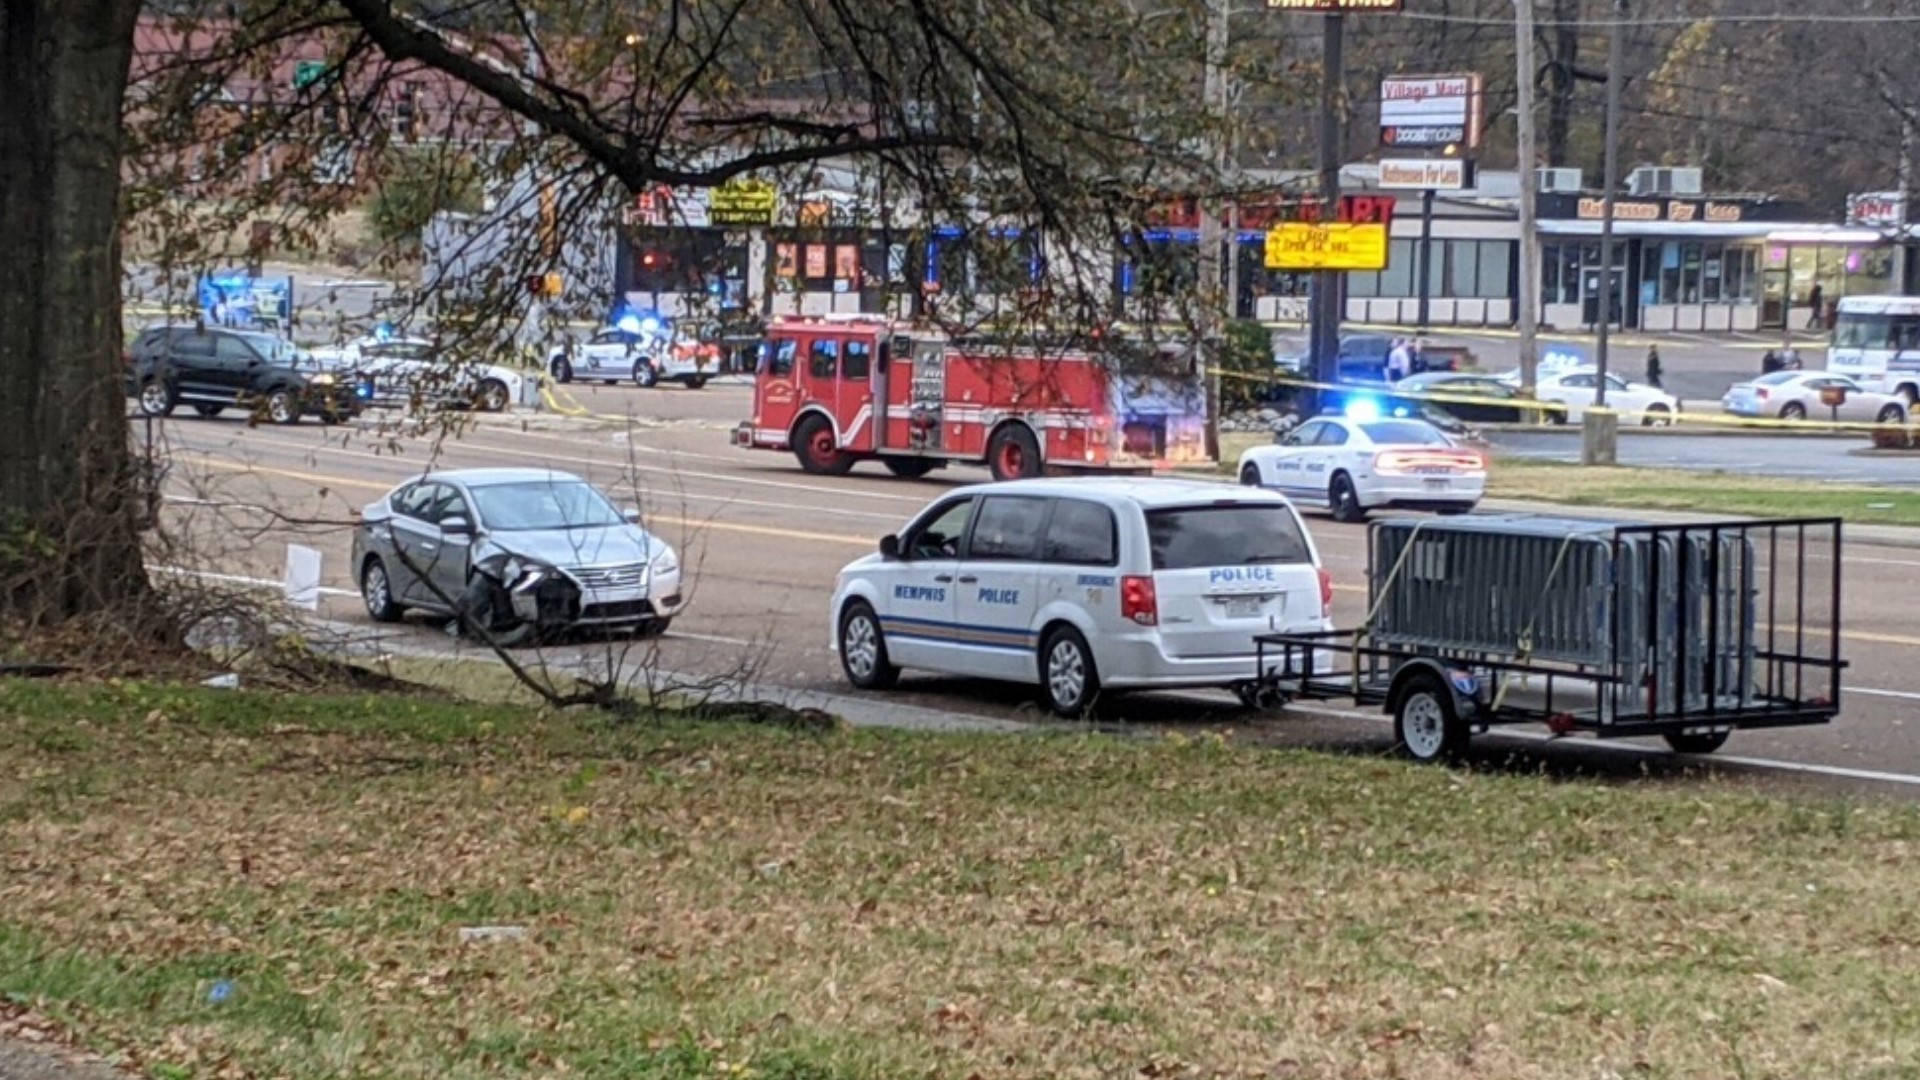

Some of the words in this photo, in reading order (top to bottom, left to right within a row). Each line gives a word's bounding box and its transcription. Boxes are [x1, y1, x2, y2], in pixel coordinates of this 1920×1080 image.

[1384, 83, 1429, 102] Village
[1435, 81, 1465, 95] Mart
[1426, 163, 1440, 184] For
[1577, 198, 1661, 220] Matresses
[1668, 200, 1696, 221] For
[1704, 201, 1741, 221] Less
[1210, 567, 1276, 583] POLICE
[894, 584, 946, 603] MEMPHIS
[978, 587, 1020, 605] POLICE
